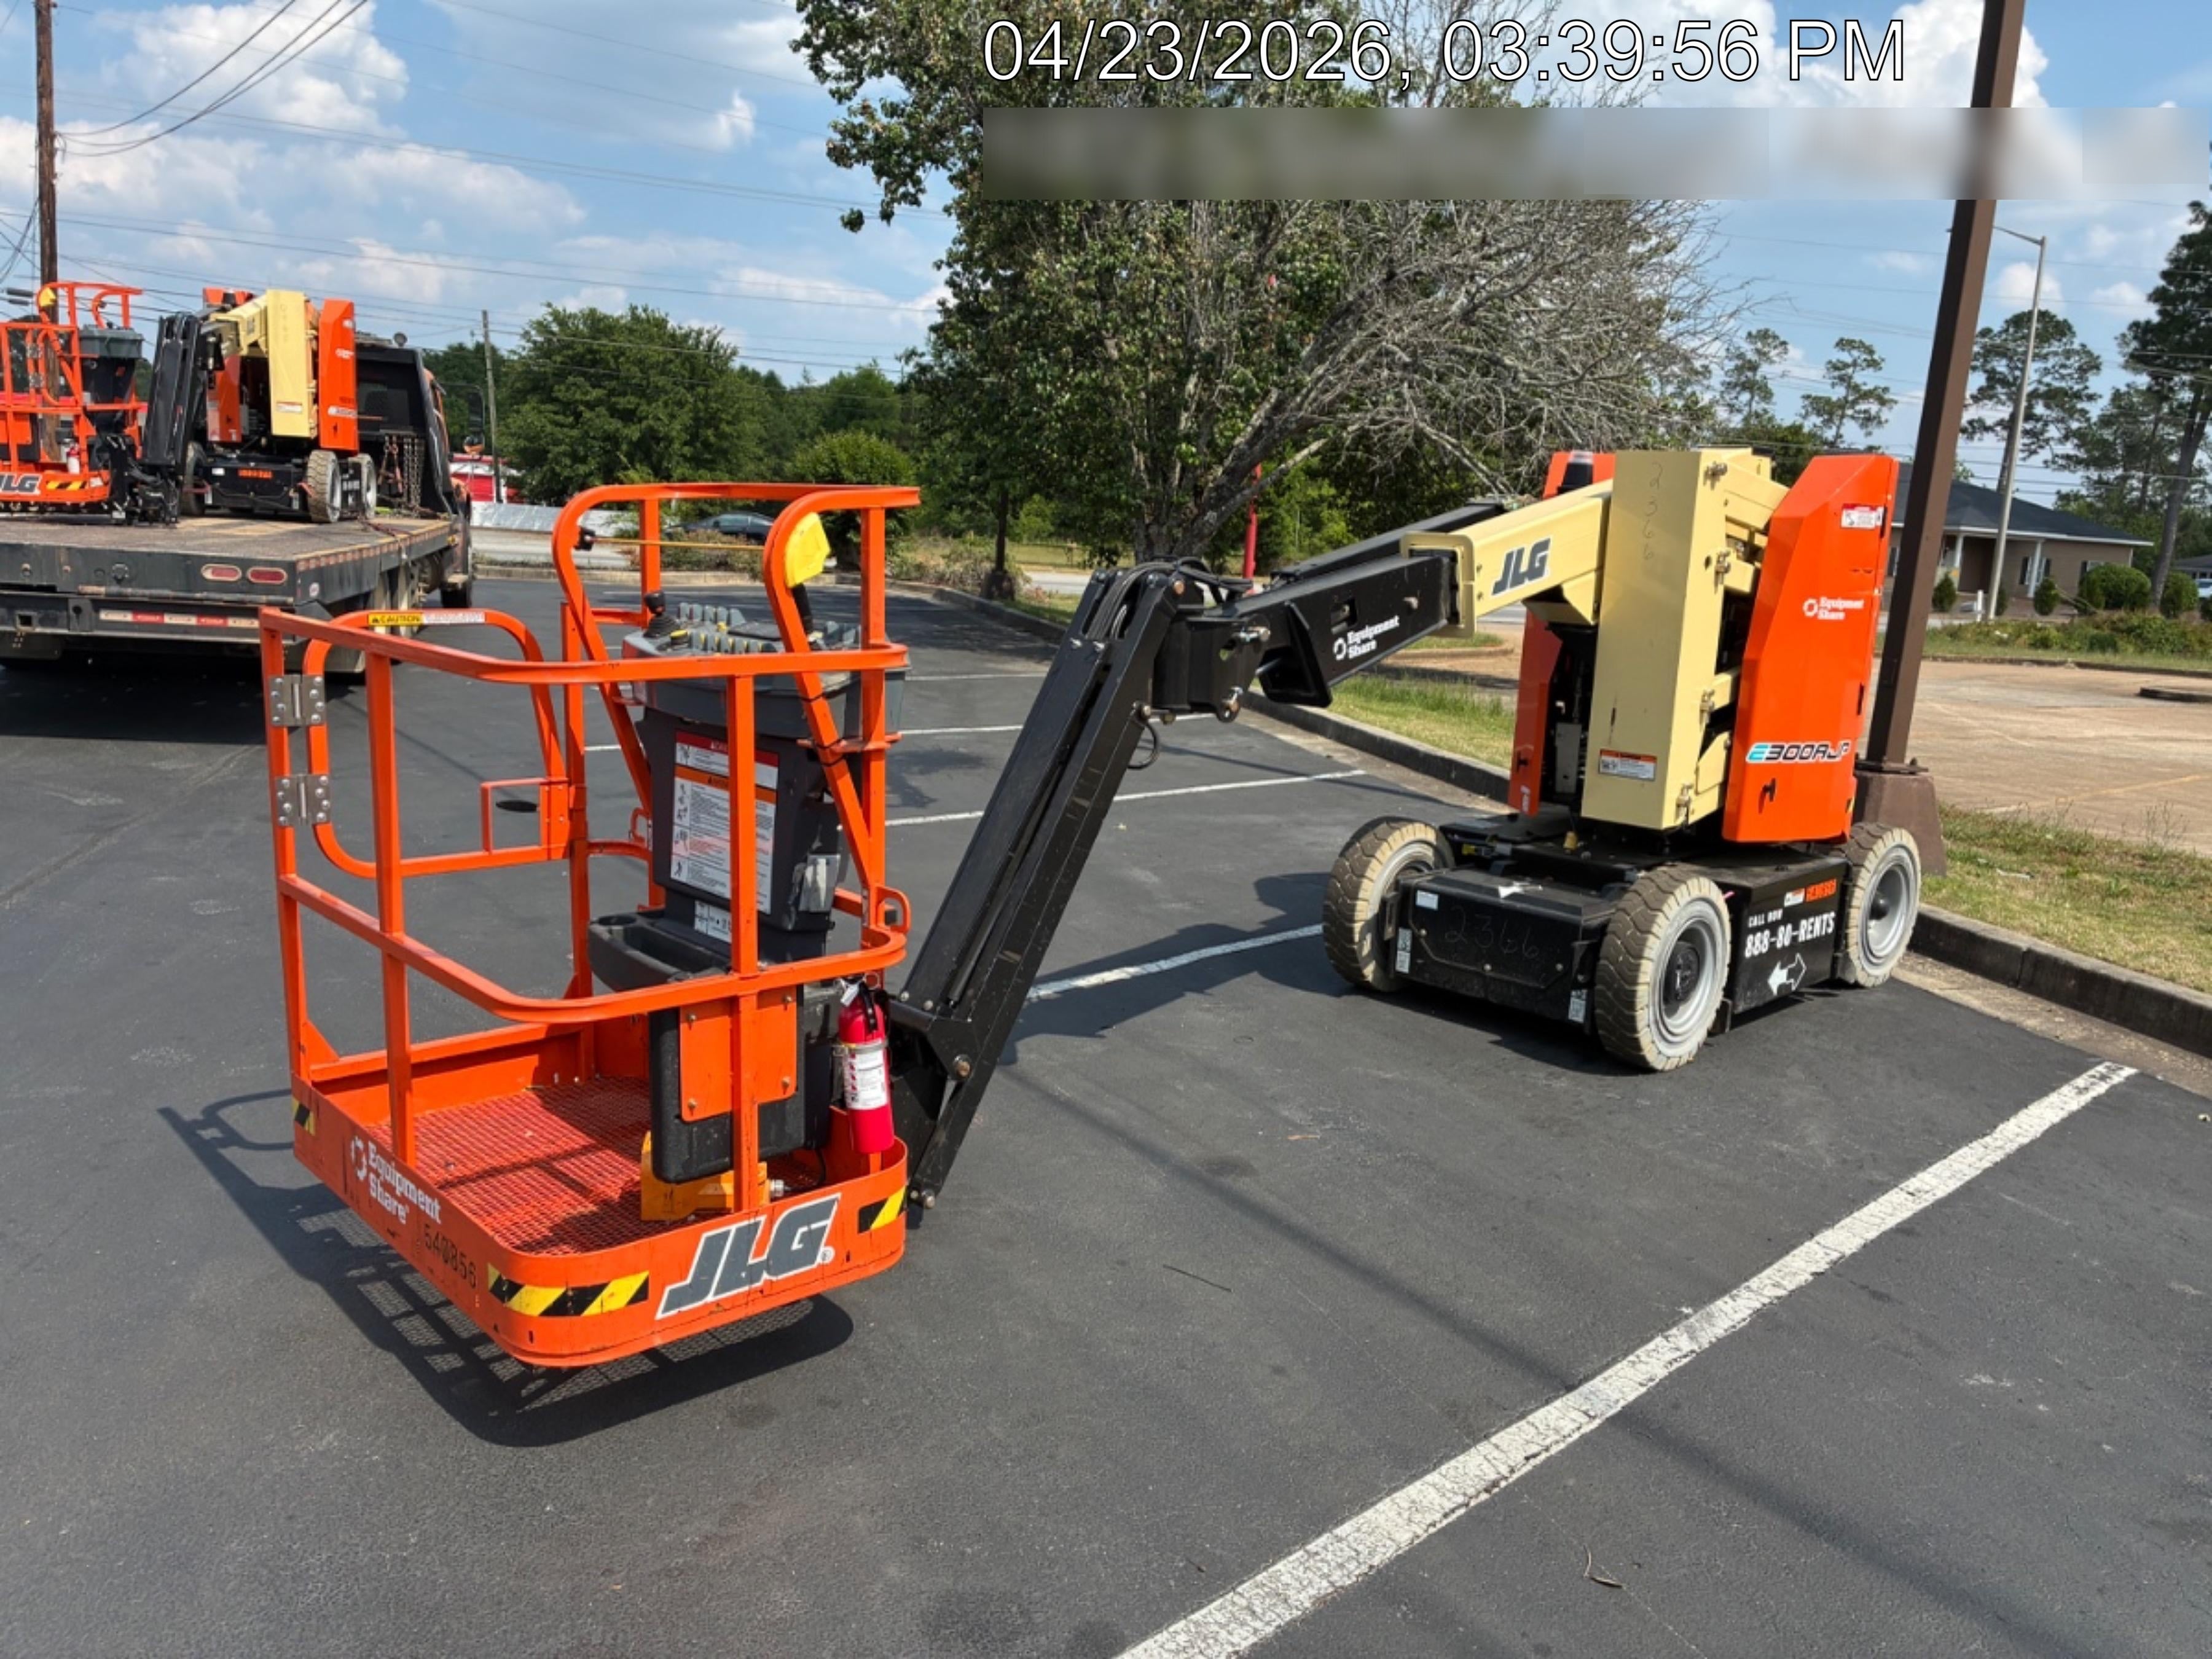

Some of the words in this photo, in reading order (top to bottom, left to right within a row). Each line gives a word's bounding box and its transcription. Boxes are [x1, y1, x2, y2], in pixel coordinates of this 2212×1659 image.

[0, 473, 41, 494] LG
[1491, 536, 1552, 596] JLG
[1818, 610, 1845, 620] Share
[1819, 596, 1864, 610] Equipment
[379, 614, 420, 623] CAUTION
[1347, 614, 1400, 644] Equipment
[1348, 639, 1377, 659] Share
[1747, 741, 1851, 763] E300AJP
[1445, 904, 1540, 959] 2366
[1748, 913, 1765, 928] CALL
[1744, 911, 1836, 959] 888-80-RENTS
[368, 1140, 442, 1225] Equipment
[369, 1172, 407, 1225] Share
[655, 1193, 841, 1320] JLG
